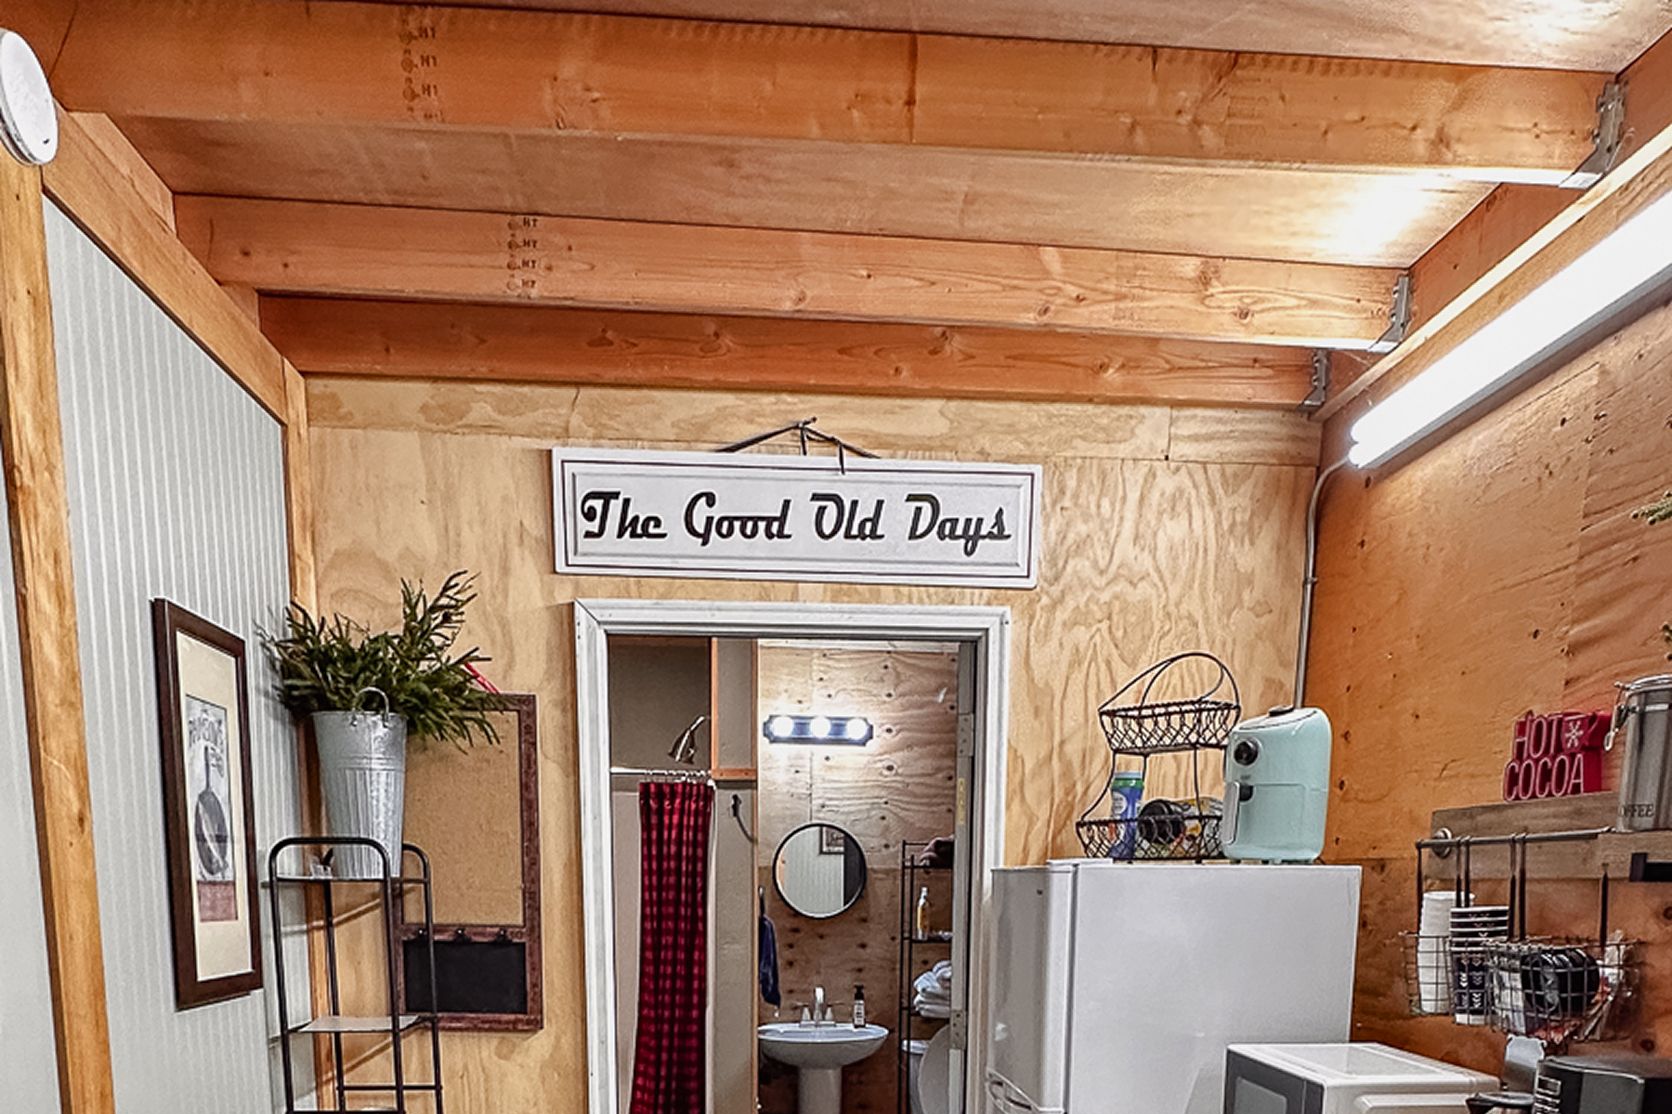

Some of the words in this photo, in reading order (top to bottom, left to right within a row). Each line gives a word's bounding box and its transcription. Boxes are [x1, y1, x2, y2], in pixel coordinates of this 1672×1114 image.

[580, 490, 668, 540] The
[683, 491, 793, 547] Good
[809, 492, 886, 542] Old
[904, 493, 1012, 558] Days
[1513, 714, 1564, 761] HOT
[1504, 753, 1585, 801] COCOA
